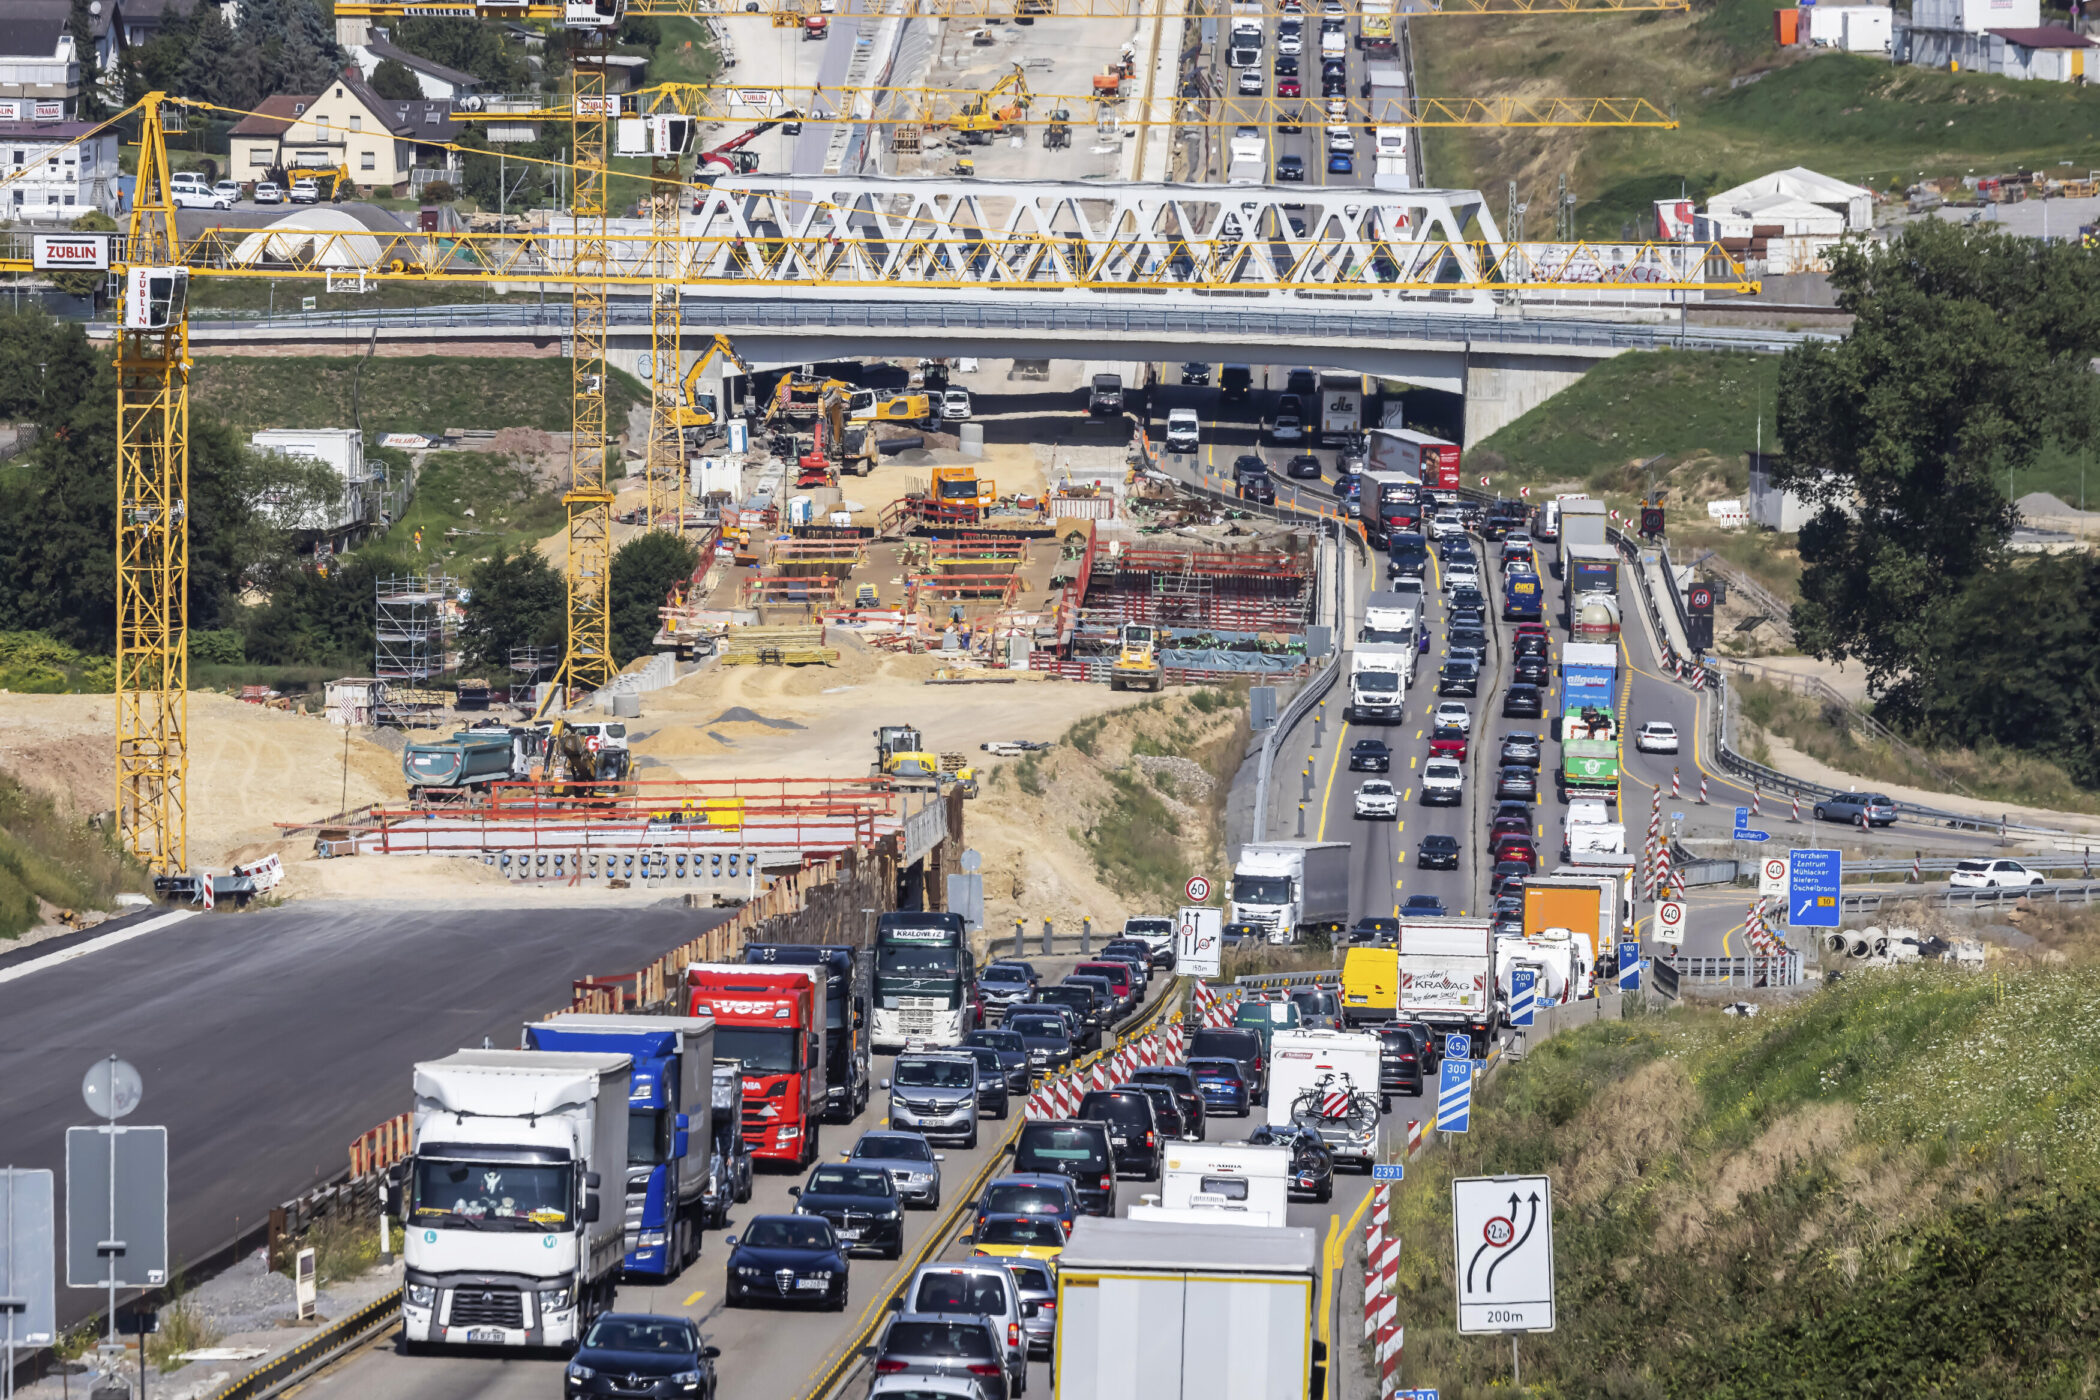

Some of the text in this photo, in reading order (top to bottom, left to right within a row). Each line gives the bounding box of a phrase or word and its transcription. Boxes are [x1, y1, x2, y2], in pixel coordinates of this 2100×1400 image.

[46, 245, 97, 259] ZÜBLIN
[138, 271, 147, 325] ZÜBLIN
[1694, 593, 1708, 605] 60
[1792, 852, 1829, 860] Pforzheim
[1769, 864, 1783, 876] 40
[1190, 882, 1206, 896] 60
[1663, 908, 1678, 920] 40
[1623, 944, 1635, 952] 100
[1515, 973, 1531, 982] 200
[1414, 979, 1470, 991] KRAVAG
[1449, 1042, 1467, 1052] 45a
[1446, 1063, 1467, 1074] 300
[1451, 1075, 1461, 1083] m
[742, 1081, 761, 1090] NIA
[1375, 1167, 1401, 1177] 239.1
[427, 1233, 435, 1242] L
[1486, 1311, 1524, 1324] 200m
